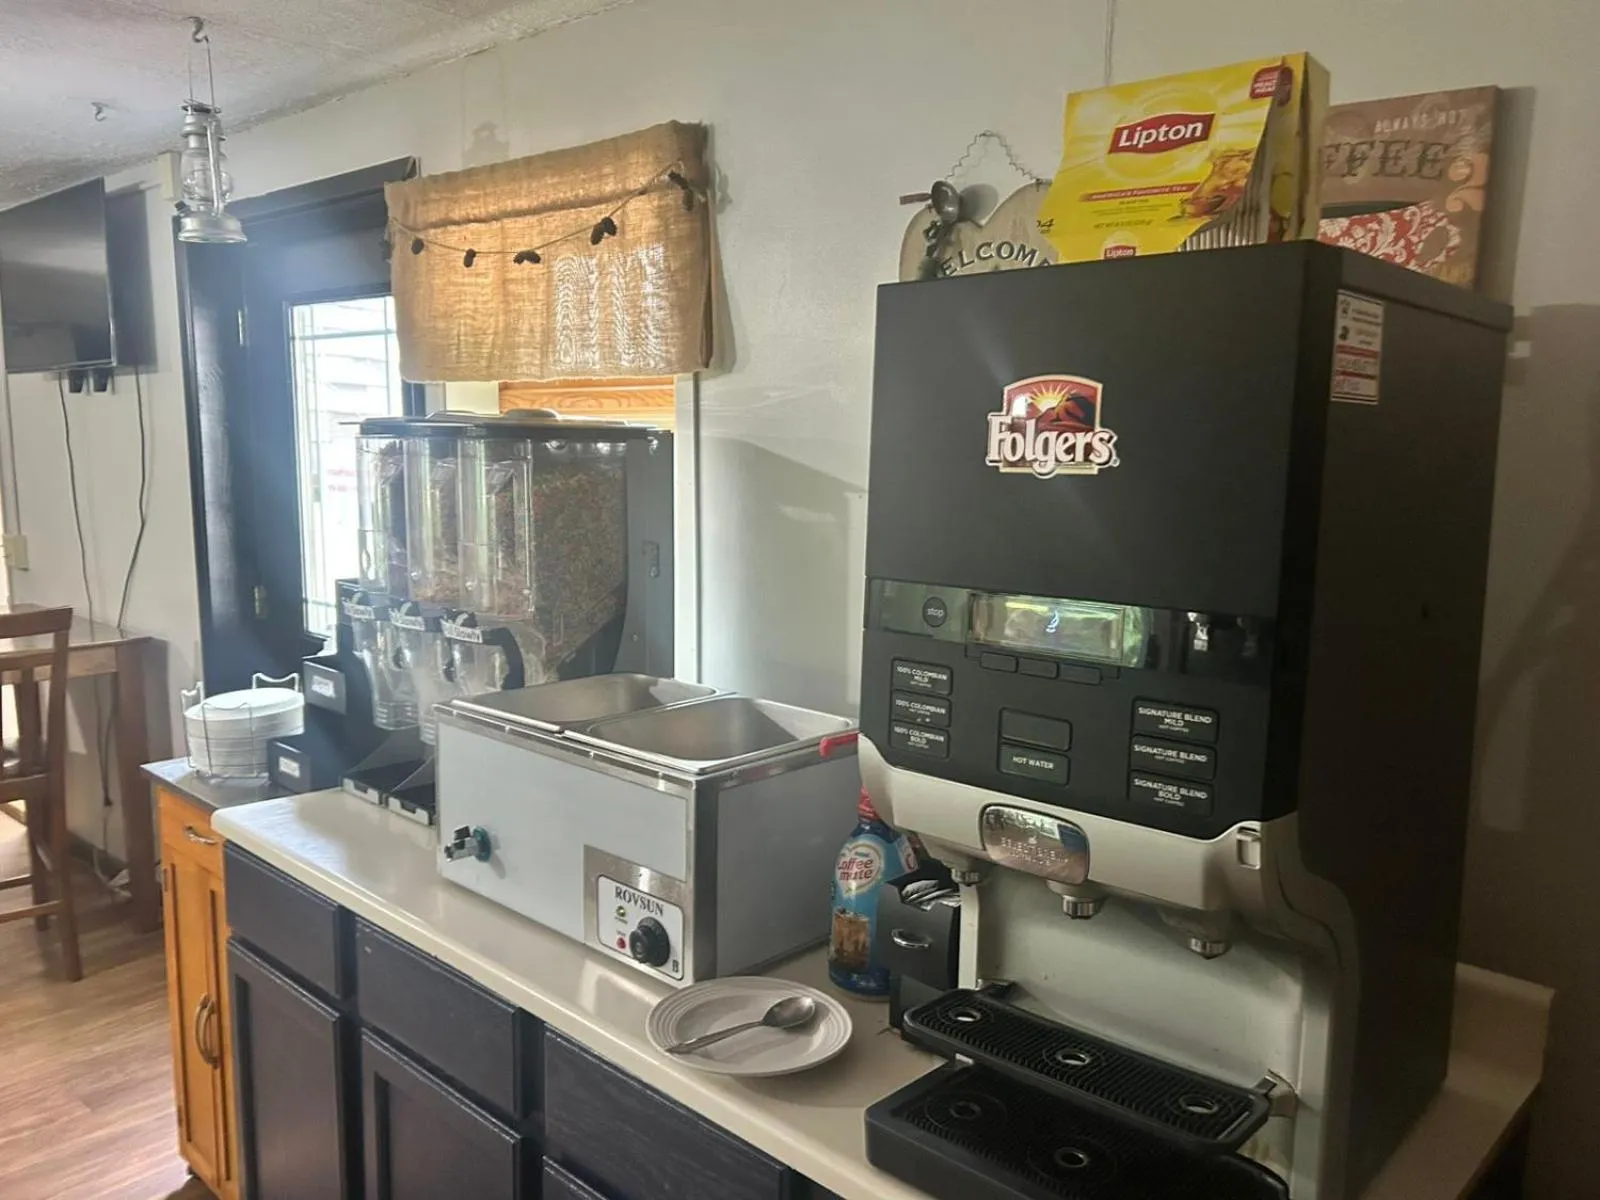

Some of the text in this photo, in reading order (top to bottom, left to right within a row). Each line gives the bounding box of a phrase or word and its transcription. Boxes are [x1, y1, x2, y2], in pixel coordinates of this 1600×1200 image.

[1118, 121, 1203, 148] Lipton
[1318, 139, 1450, 181] FFEE
[937, 240, 1052, 276] ELCOM
[1105, 247, 1135, 258] Lipton
[987, 414, 1112, 475] Folgers
[1138, 707, 1213, 724] SIGNATURE BLEND
[1164, 718, 1185, 727] MILD
[1012, 755, 1054, 770] HOT WATER
[1134, 744, 1178, 758] SIGNATURE
[1179, 751, 1208, 763] BLEND
[1134, 778, 1208, 799] SIGNATURE BLEND
[1158, 790, 1182, 801] BOLD
[614, 886, 664, 917] ROVSUN
